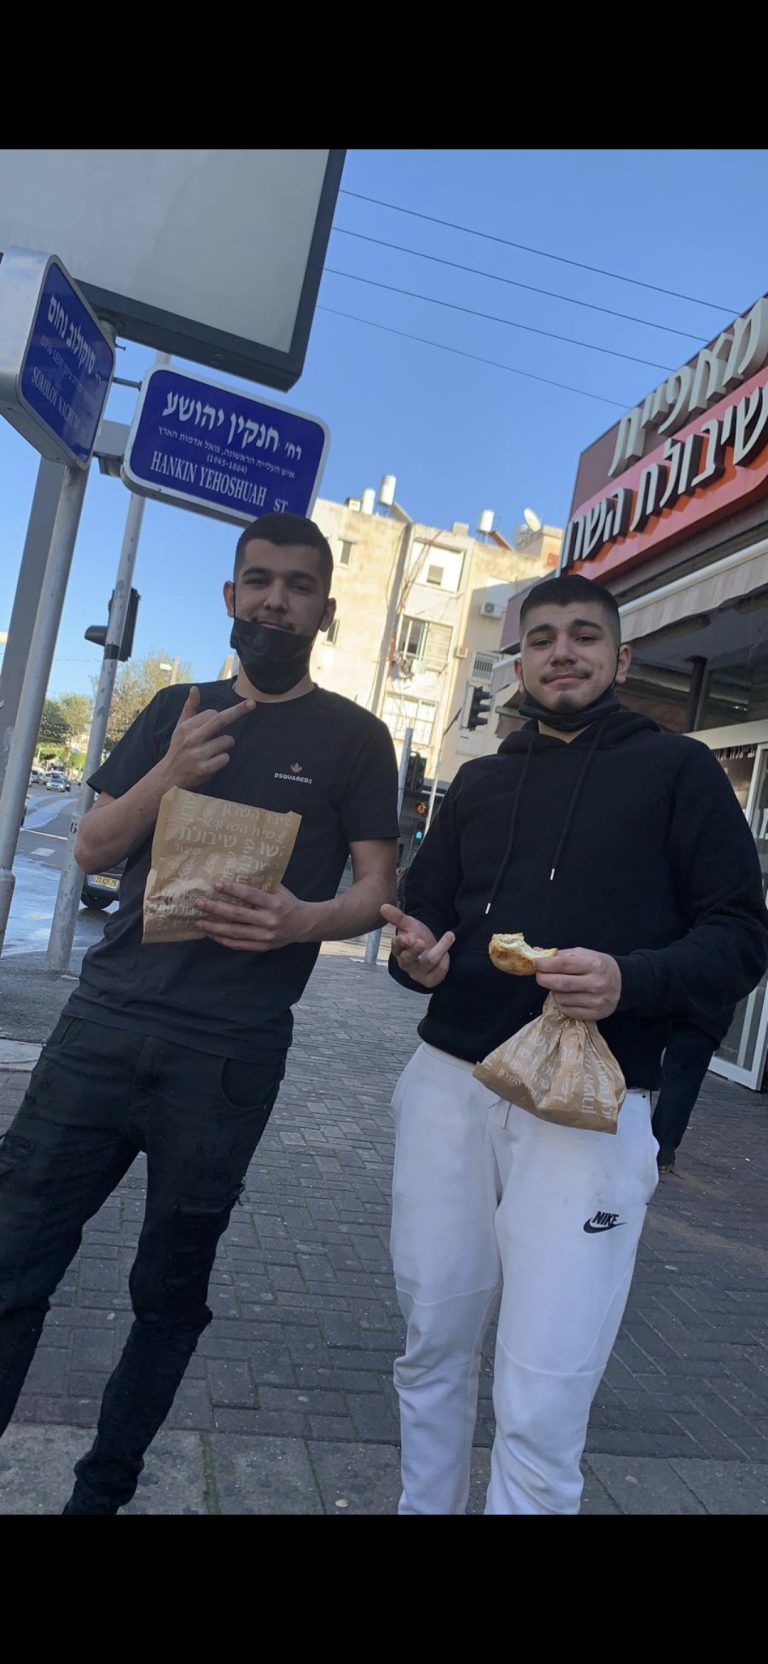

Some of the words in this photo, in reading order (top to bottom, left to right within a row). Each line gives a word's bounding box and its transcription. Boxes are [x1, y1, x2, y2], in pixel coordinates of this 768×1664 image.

[162, 391, 225, 430] יהושע
[227, 413, 280, 453] חנקין
[630, 381, 768, 533] שיבולת
[150, 450, 198, 484] HANKIN
[199, 466, 268, 507] YEHOSHUAH
[273, 498, 289, 514] ST
[274, 772, 313, 784] DSQUARED2
[178, 826, 237, 848] שיבולת
[592, 1211, 619, 1226] NIKE
